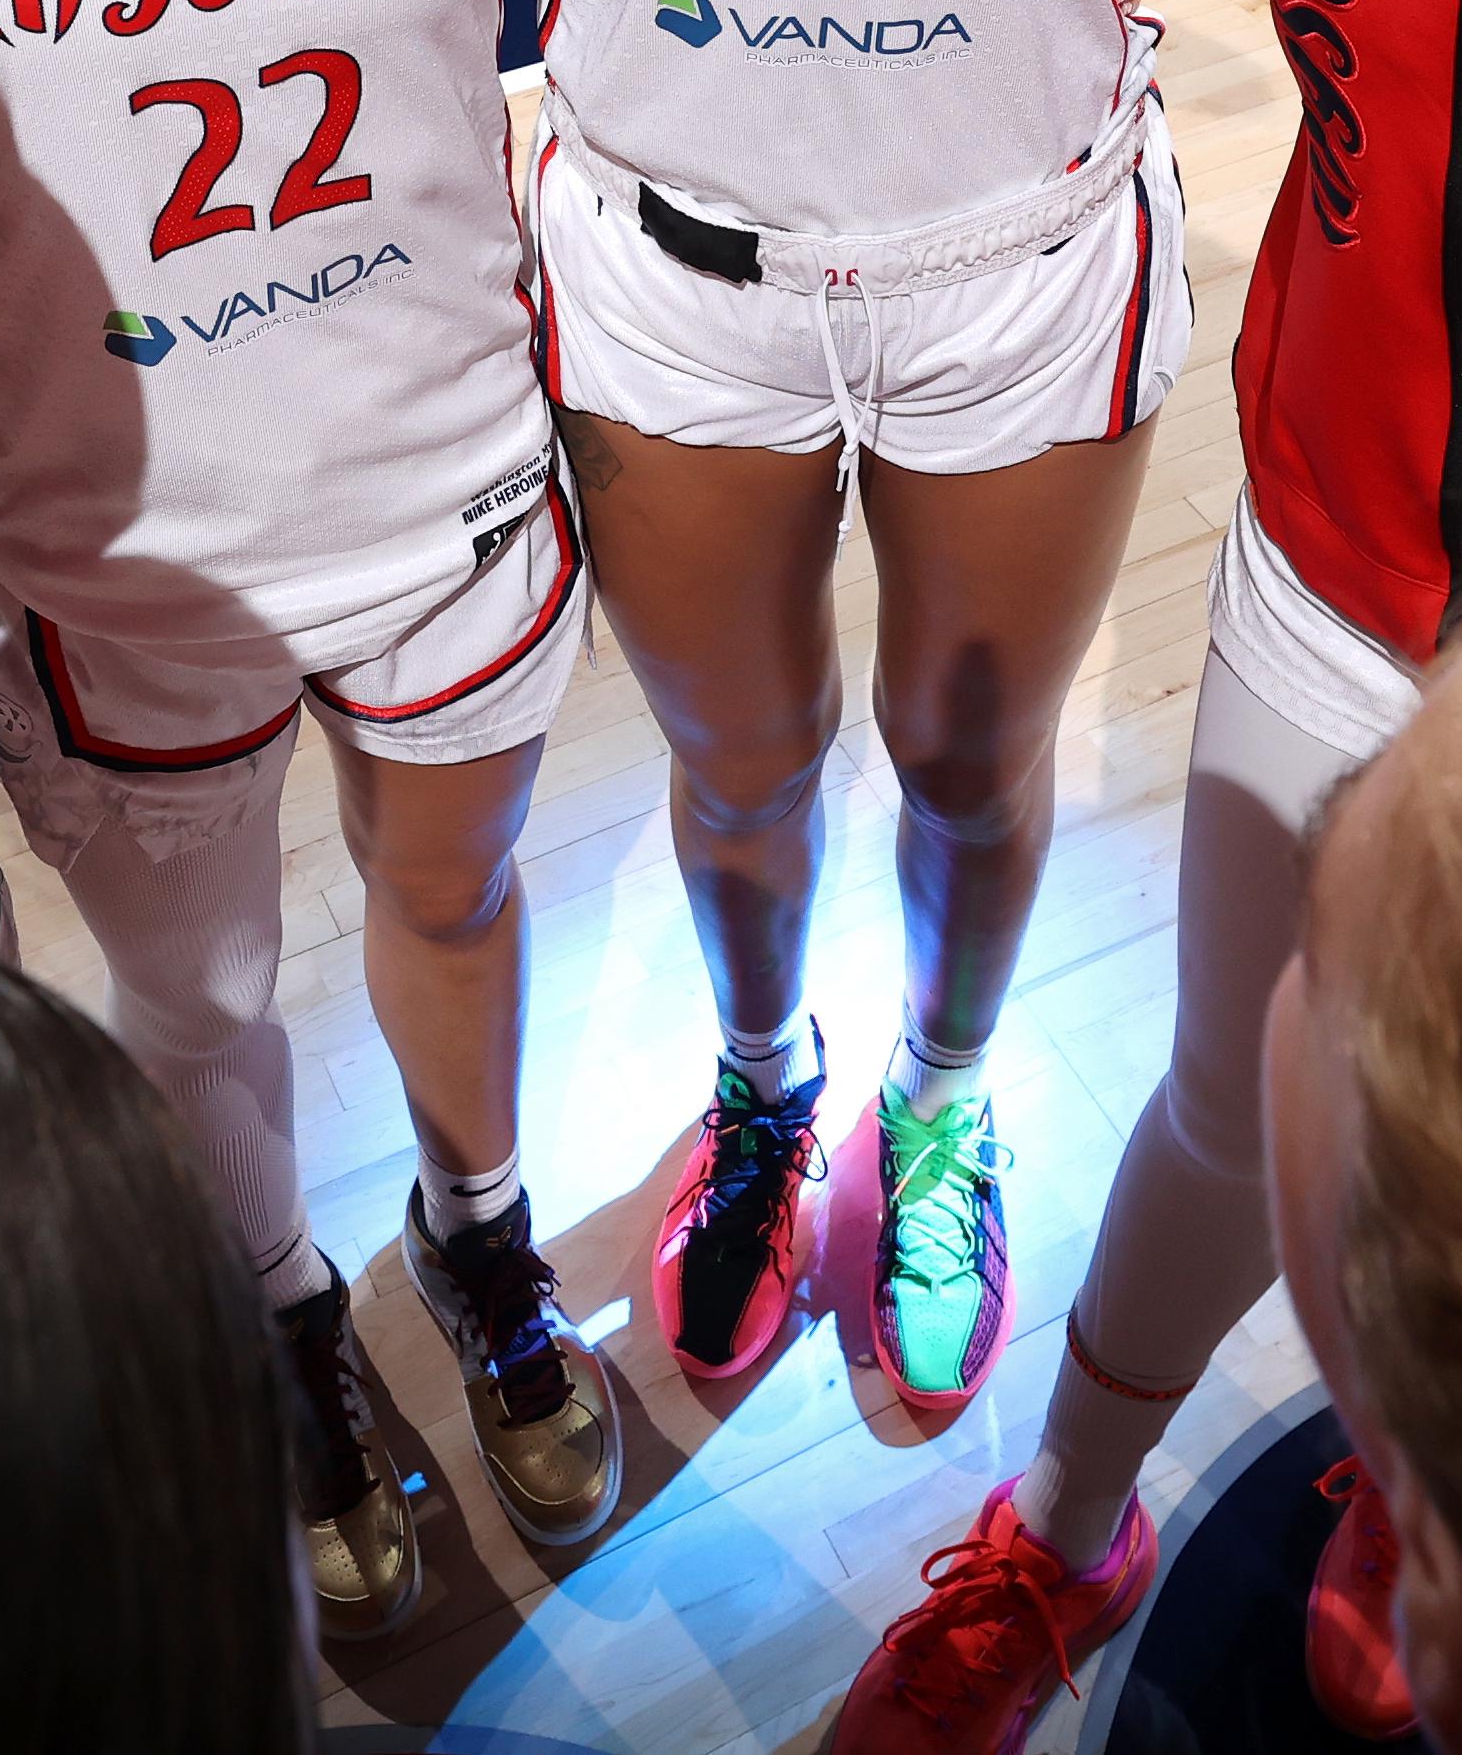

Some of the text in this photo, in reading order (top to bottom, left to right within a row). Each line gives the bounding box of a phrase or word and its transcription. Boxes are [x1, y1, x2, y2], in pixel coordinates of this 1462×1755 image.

[727, 6, 974, 56] VANDA
[746, 52, 937, 71] PHARMACEUTICALS
[128, 47, 373, 263] 22
[180, 243, 412, 344] VANDA
[207, 279, 378, 358] PHARMACEUTICALS
[461, 464, 549, 525] NIKE HEROINE
[470, 455, 541, 503] Washington
